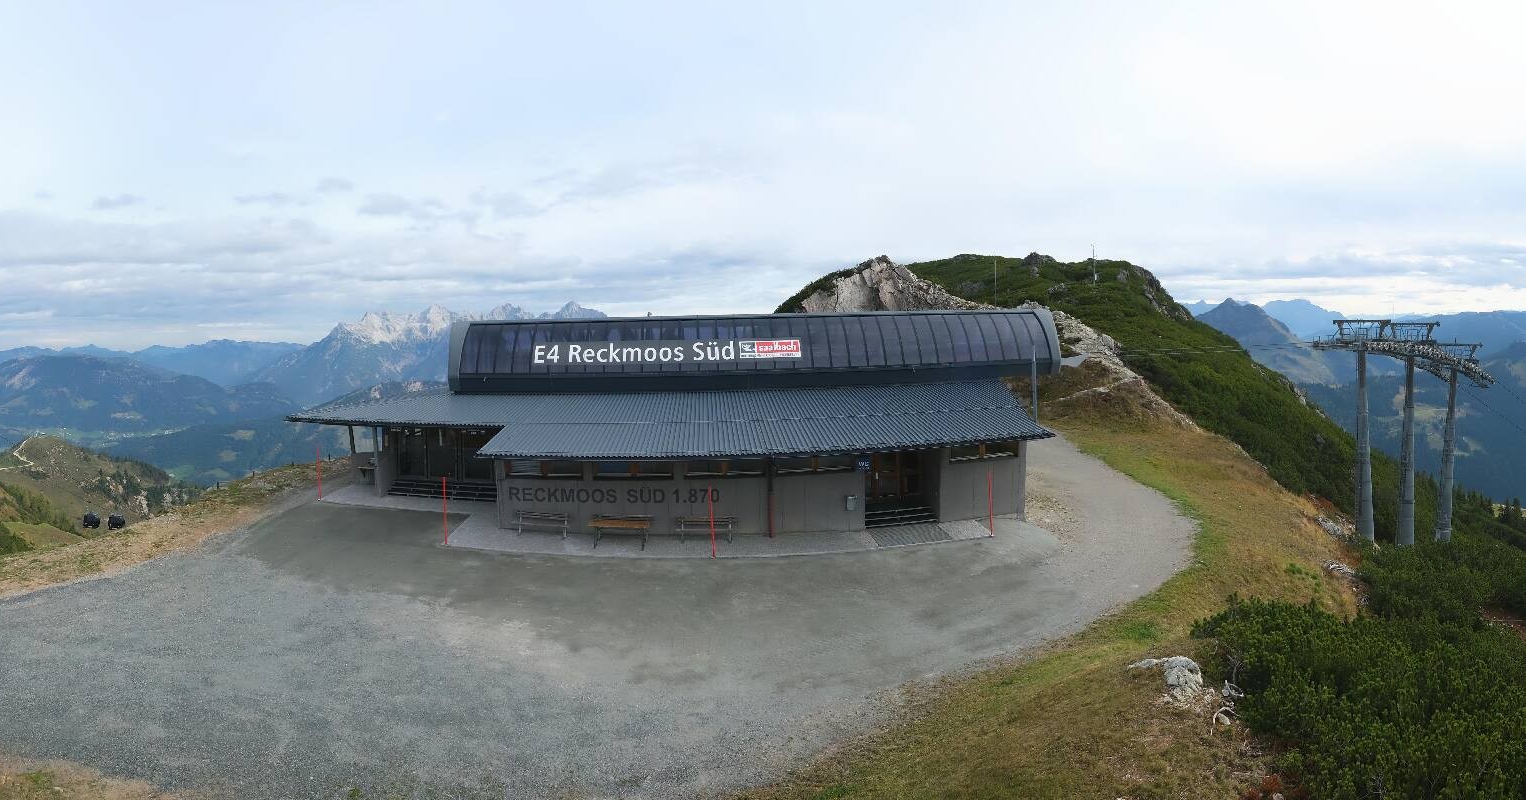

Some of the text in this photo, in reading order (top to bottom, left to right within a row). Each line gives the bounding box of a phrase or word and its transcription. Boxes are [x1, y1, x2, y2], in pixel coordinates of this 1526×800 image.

[534, 341, 735, 364] E4 Reckmoos Süd
[759, 340, 797, 352] saalbach
[508, 486, 720, 504] RECKMOOS SÜD 1.870
